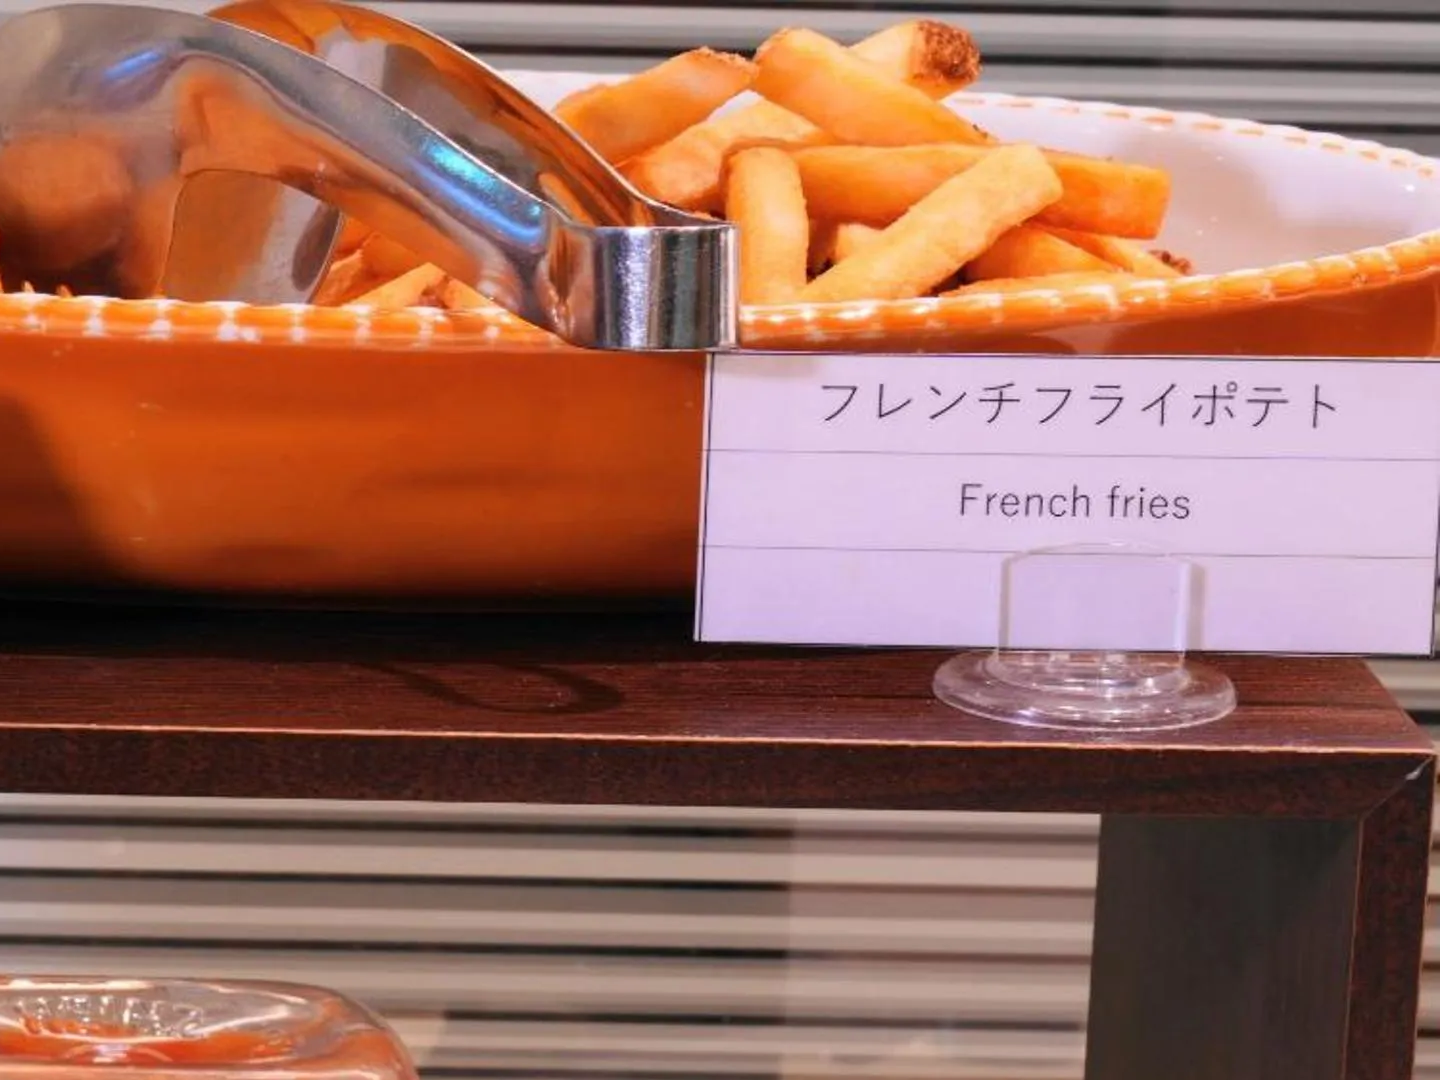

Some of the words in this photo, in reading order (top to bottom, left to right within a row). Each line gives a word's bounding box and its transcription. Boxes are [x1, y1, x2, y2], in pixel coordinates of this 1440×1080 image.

[821, 380, 1338, 429] フレンチフライポテト
[960, 483, 1092, 518] French
[1107, 486, 1191, 520] fries
